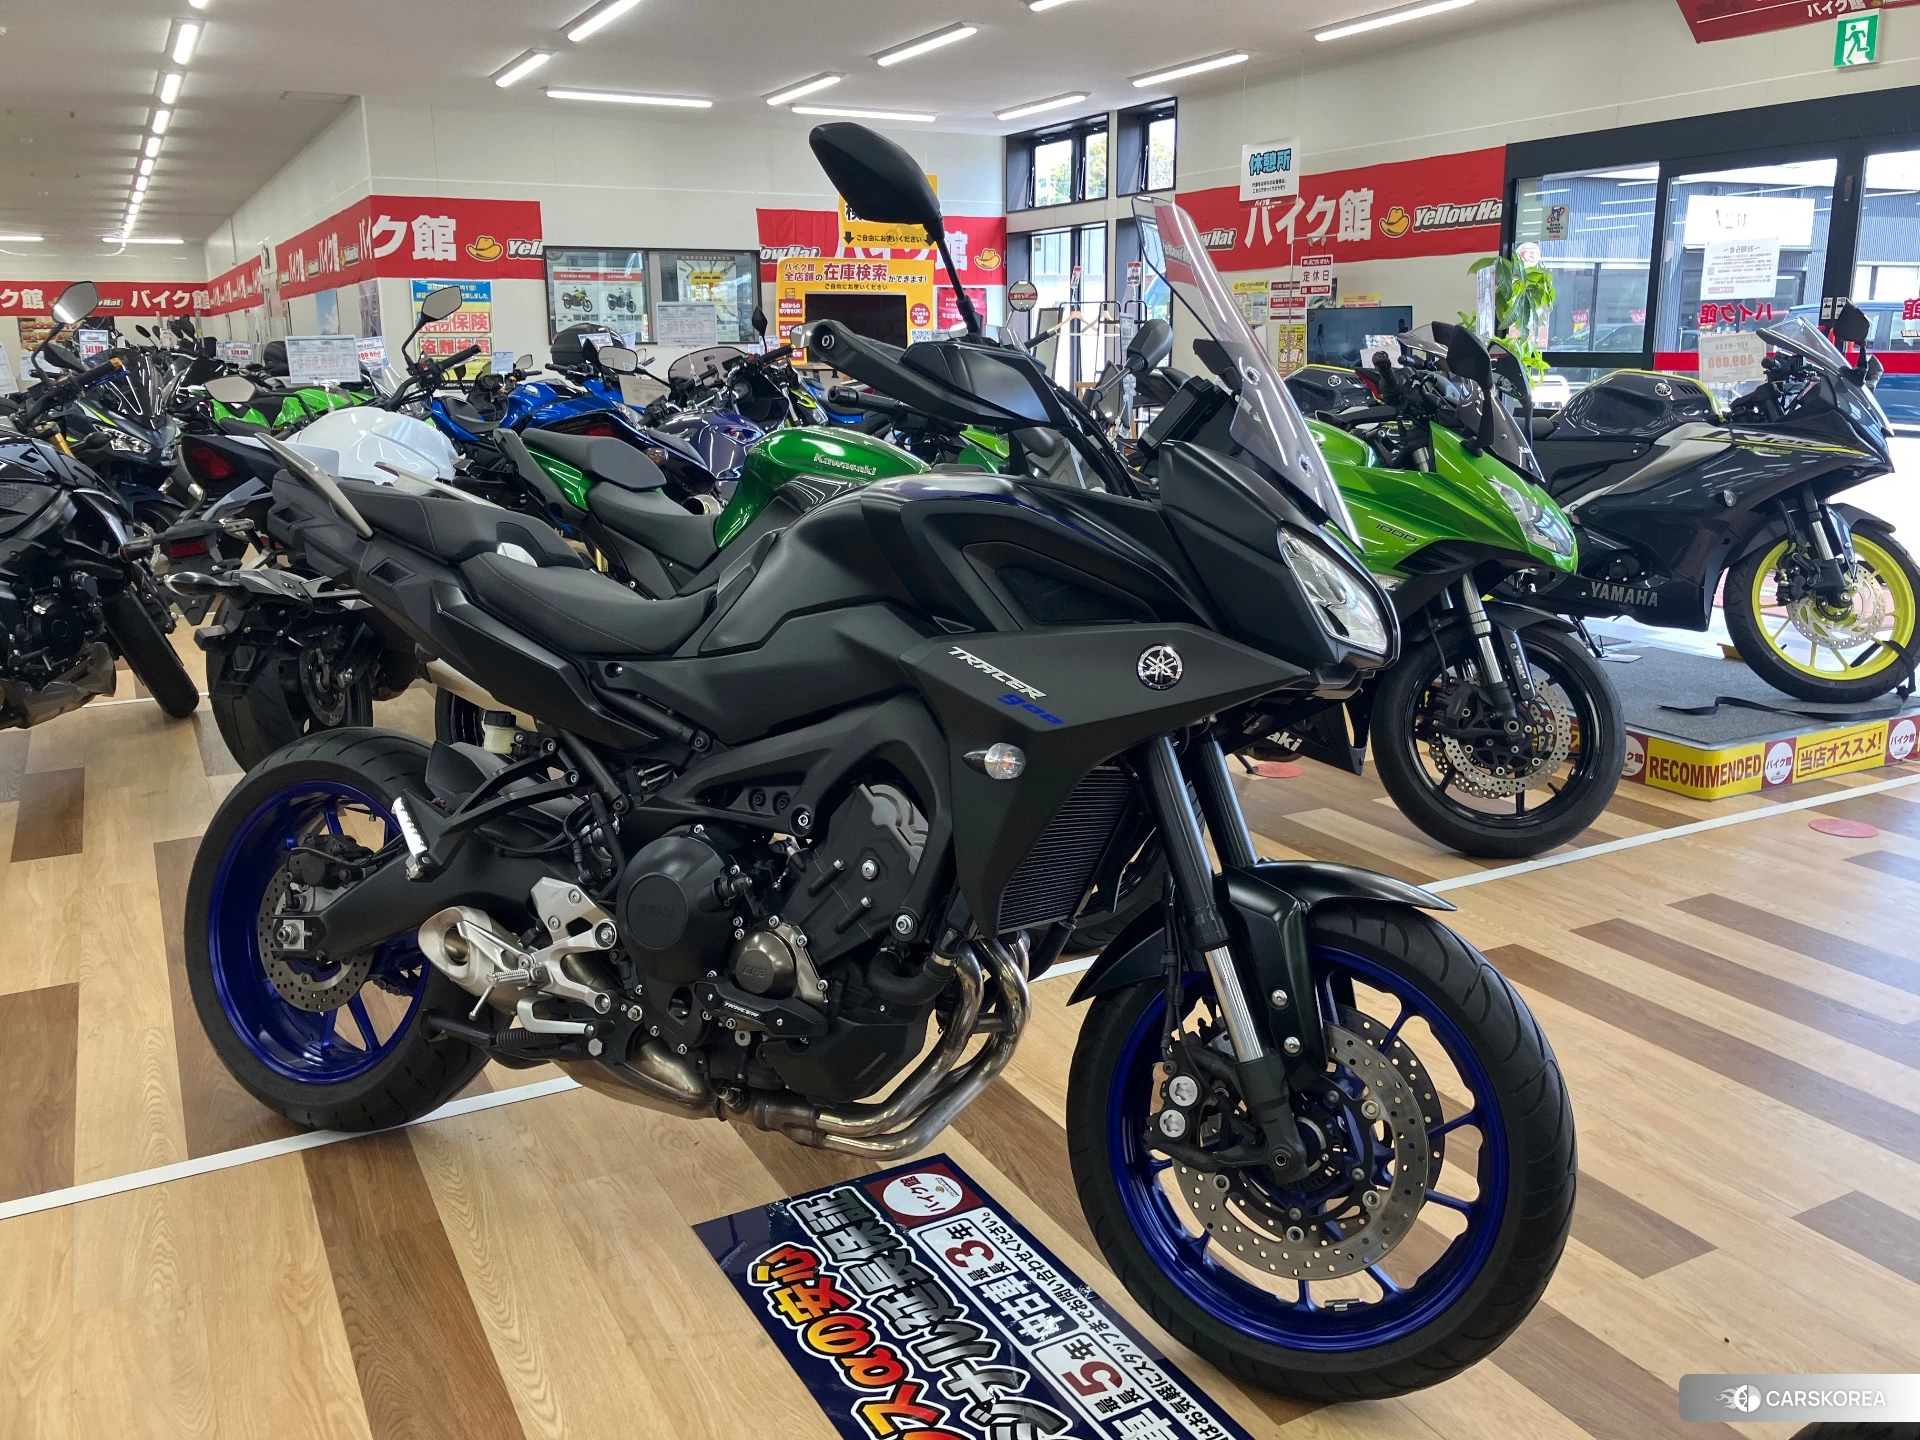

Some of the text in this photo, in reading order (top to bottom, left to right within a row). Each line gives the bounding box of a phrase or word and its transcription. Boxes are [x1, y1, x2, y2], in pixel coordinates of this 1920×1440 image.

[1249, 148, 1292, 176] 休憩所
[1244, 187, 1374, 248] バイク館
[856, 234, 923, 243] ご自由にお使いください
[823, 262, 888, 282] 在庫検索
[1303, 270, 1329, 282] 定休日
[131, 290, 211, 310] バイク館
[452, 313, 488, 331] 保険
[813, 453, 877, 476] Kawasaki
[1376, 523, 1417, 543] 1000
[1591, 581, 1659, 608] YAMAHA
[948, 646, 1046, 700] TRACER
[998, 693, 1064, 725] 900
[1889, 733, 1917, 746] バイク館
[1765, 756, 1793, 770] バイク館
[1799, 734, 1884, 772] 当店オススメ!
[1649, 754, 1762, 788] RECOMMENDED
[722, 1001, 761, 1018] TRACER
[899, 1175, 947, 1213] バイク館
[982, 1274, 1066, 1343] 中古車
